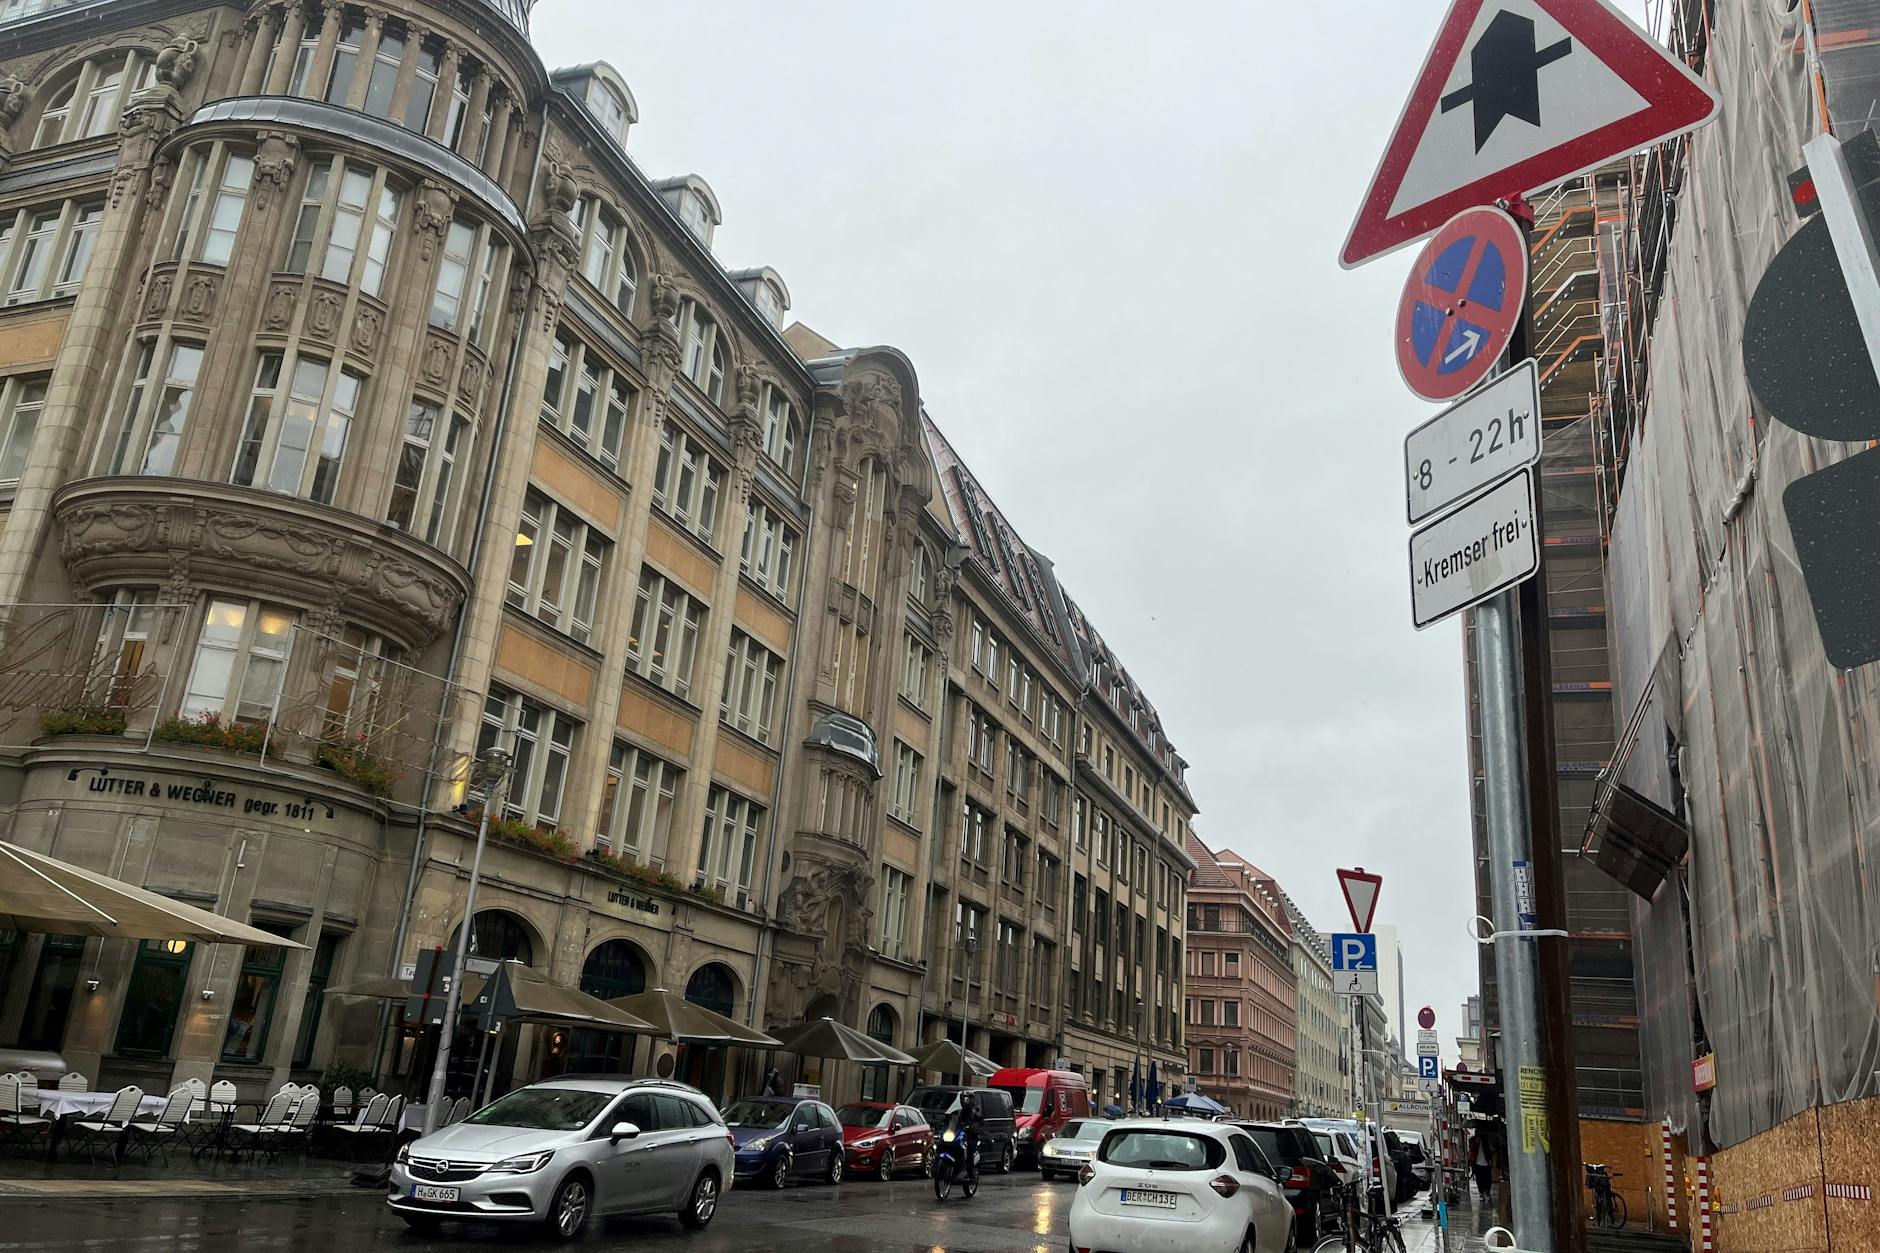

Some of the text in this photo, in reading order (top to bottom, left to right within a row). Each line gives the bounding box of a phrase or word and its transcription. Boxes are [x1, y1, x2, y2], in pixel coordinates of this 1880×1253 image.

[1420, 459, 1432, 490] 8
[1424, 509, 1520, 587] Kremser frei
[89, 777, 314, 820] LUTTER & WEGNER gegr. 1811
[1342, 939, 1365, 970] P
[1422, 1058, 1434, 1076] P
